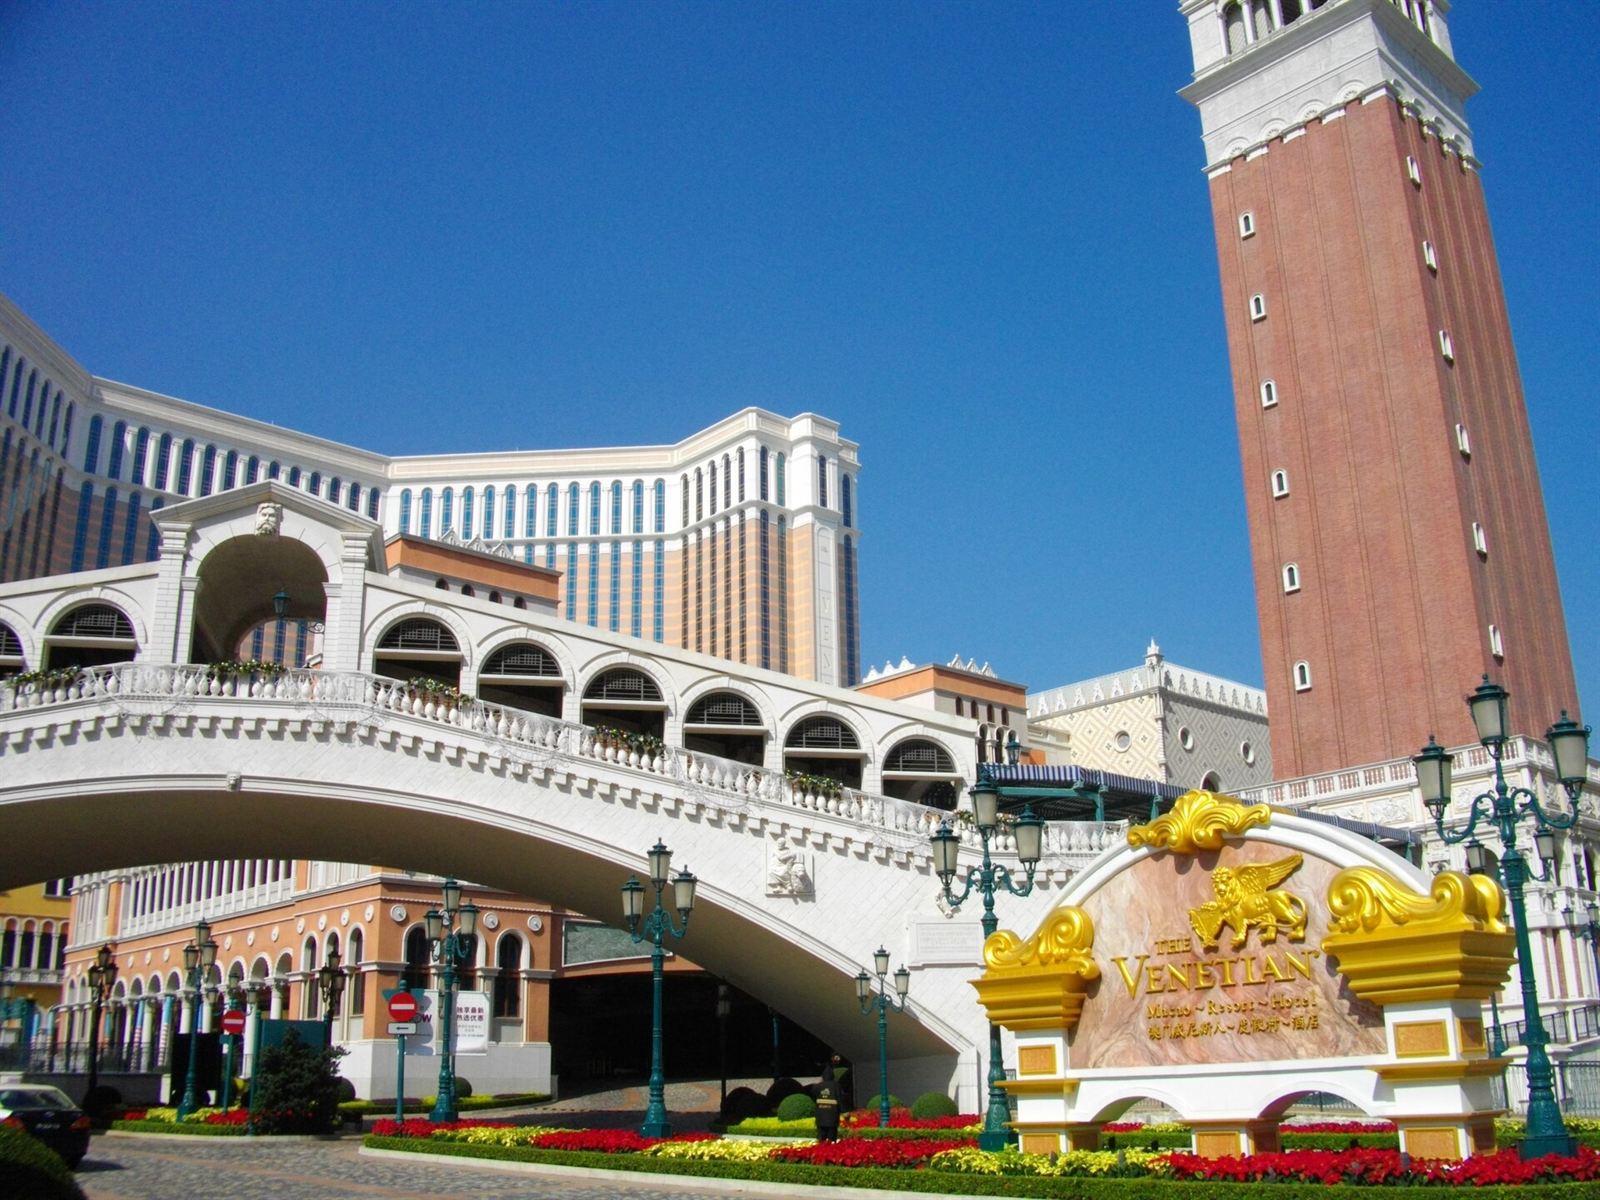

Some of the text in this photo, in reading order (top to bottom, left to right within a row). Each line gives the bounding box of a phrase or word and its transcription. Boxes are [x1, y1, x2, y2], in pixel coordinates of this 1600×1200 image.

[1155, 938, 1192, 955] THE
[1110, 950, 1315, 1000] VENETIAN
[1147, 1003, 1191, 1020] Macao
[1208, 999, 1255, 1015] Resort
[1271, 989, 1318, 1010] Hotel
